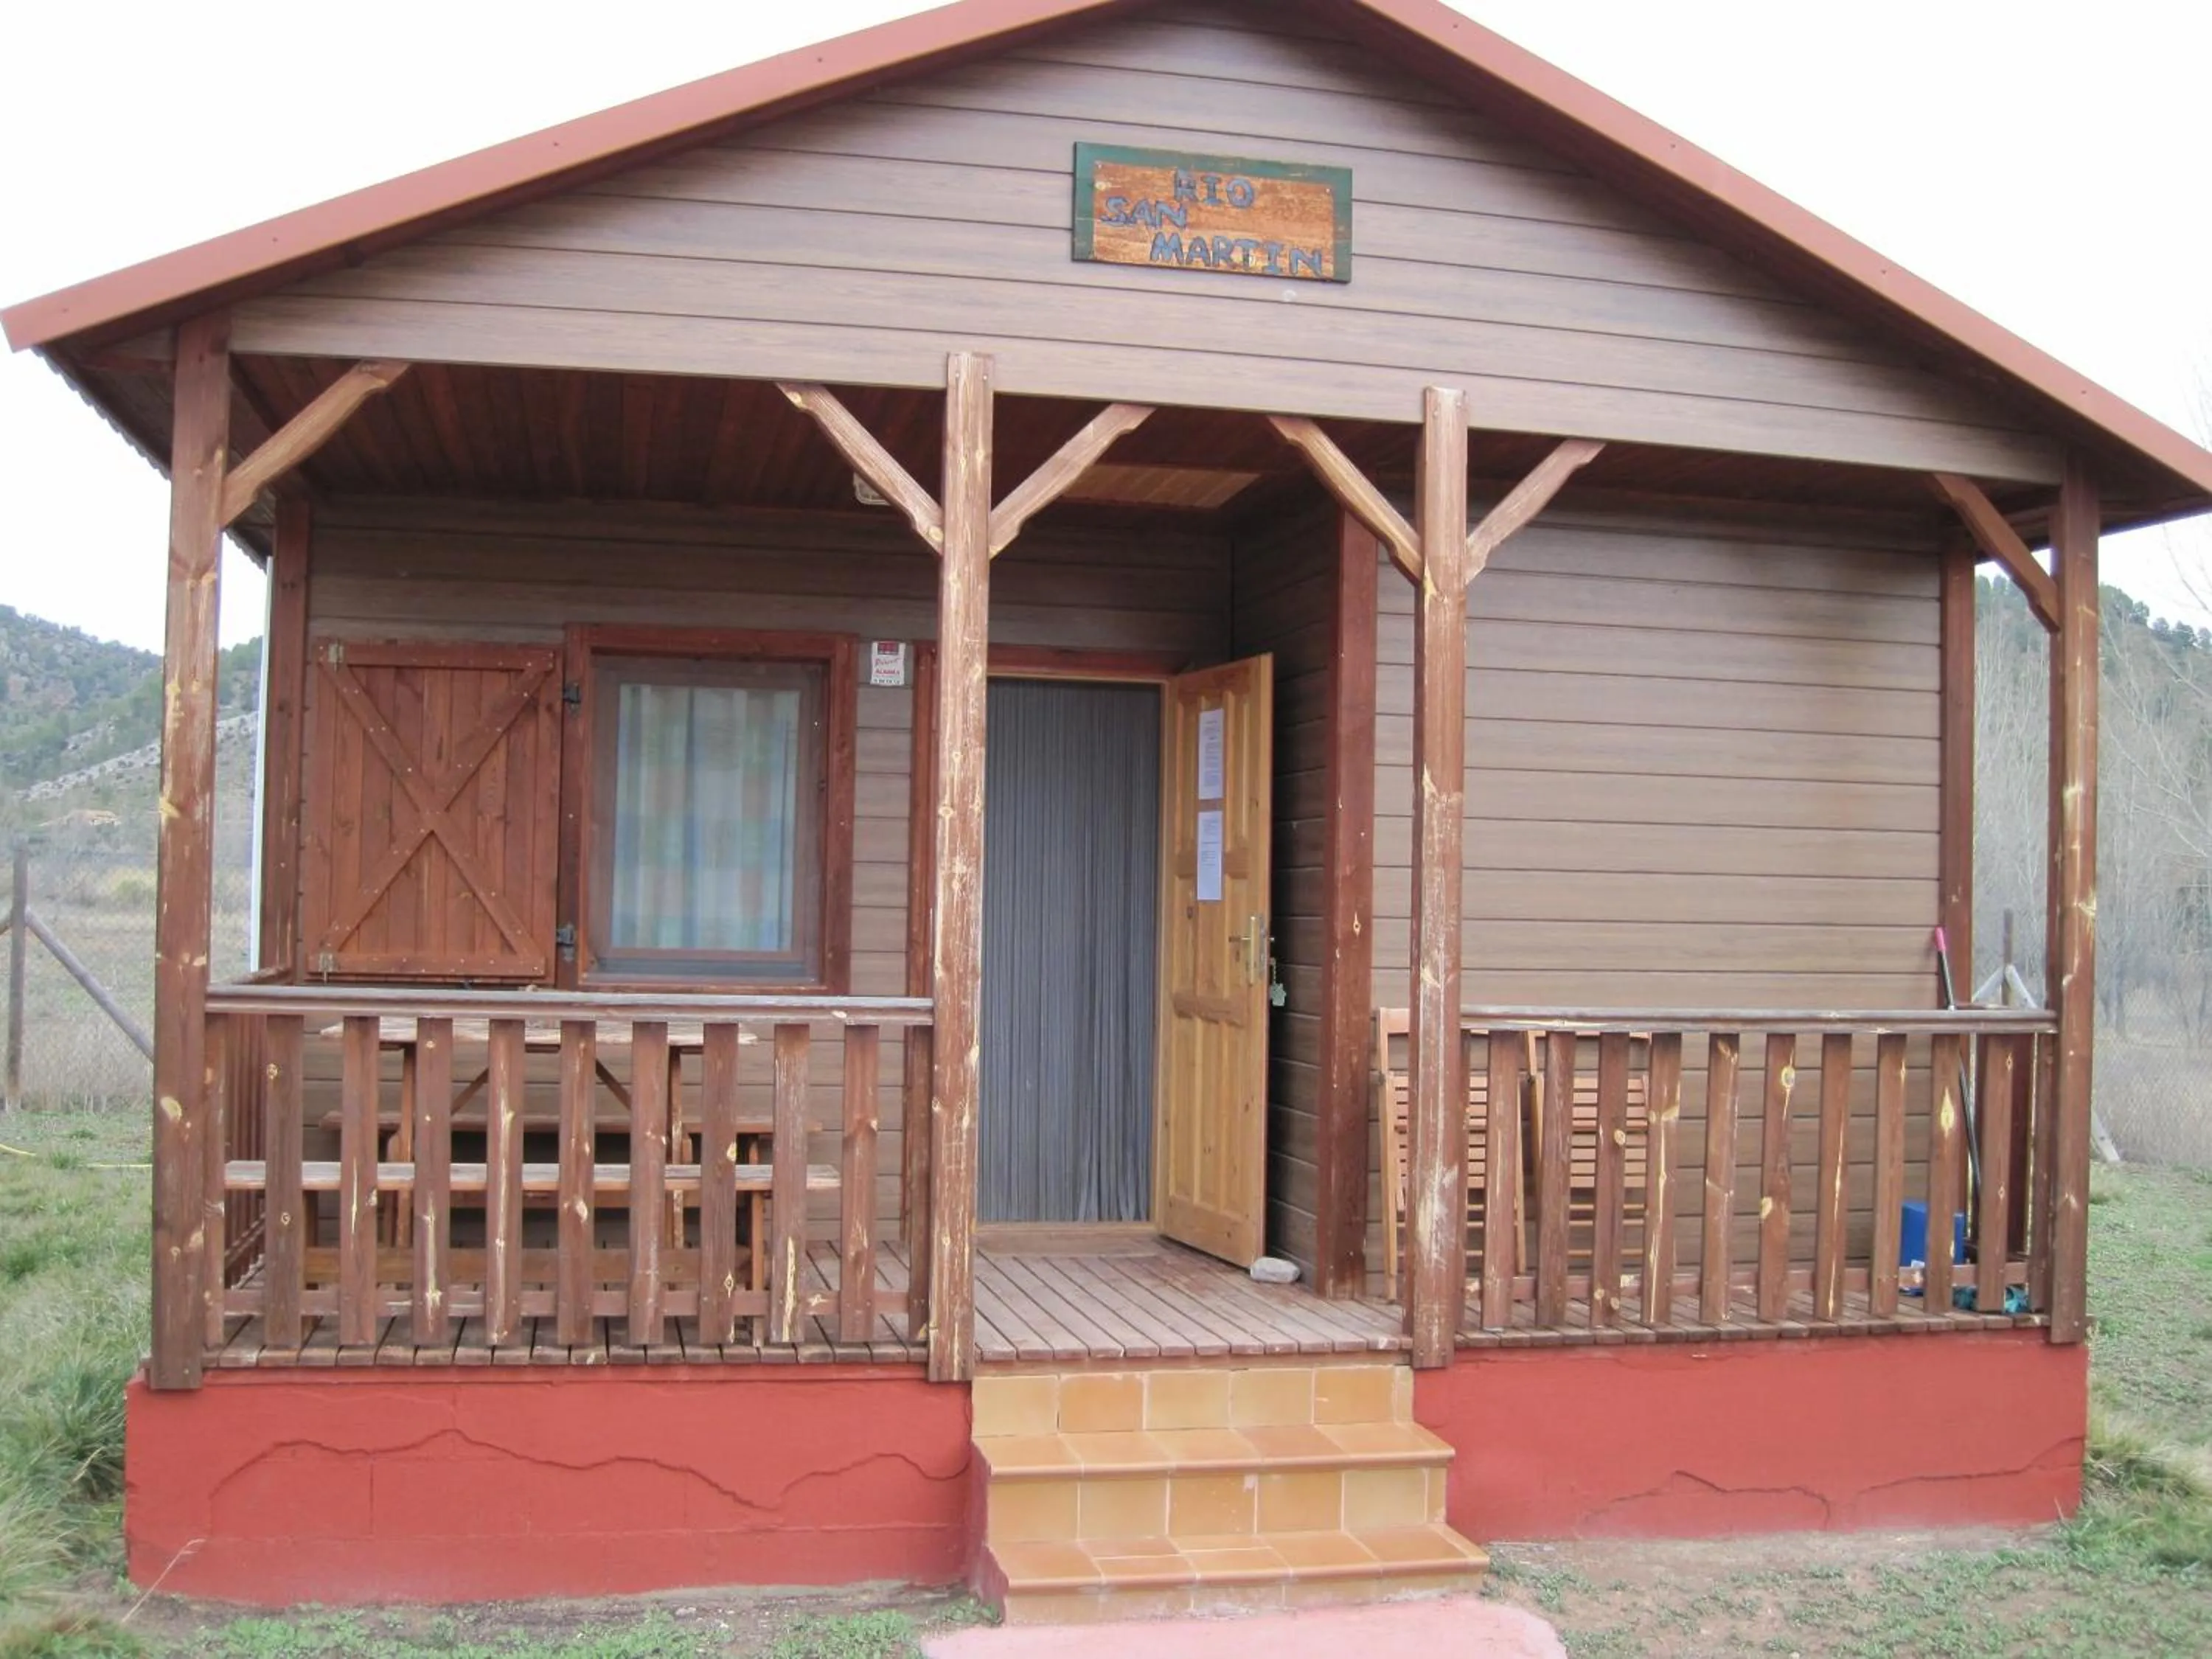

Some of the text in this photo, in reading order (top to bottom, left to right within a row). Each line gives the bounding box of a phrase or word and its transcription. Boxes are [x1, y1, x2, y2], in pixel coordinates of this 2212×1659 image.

[1174, 168, 1253, 209] RIO
[1100, 195, 1188, 230] SAN
[1150, 231, 1324, 276] MARTIN
